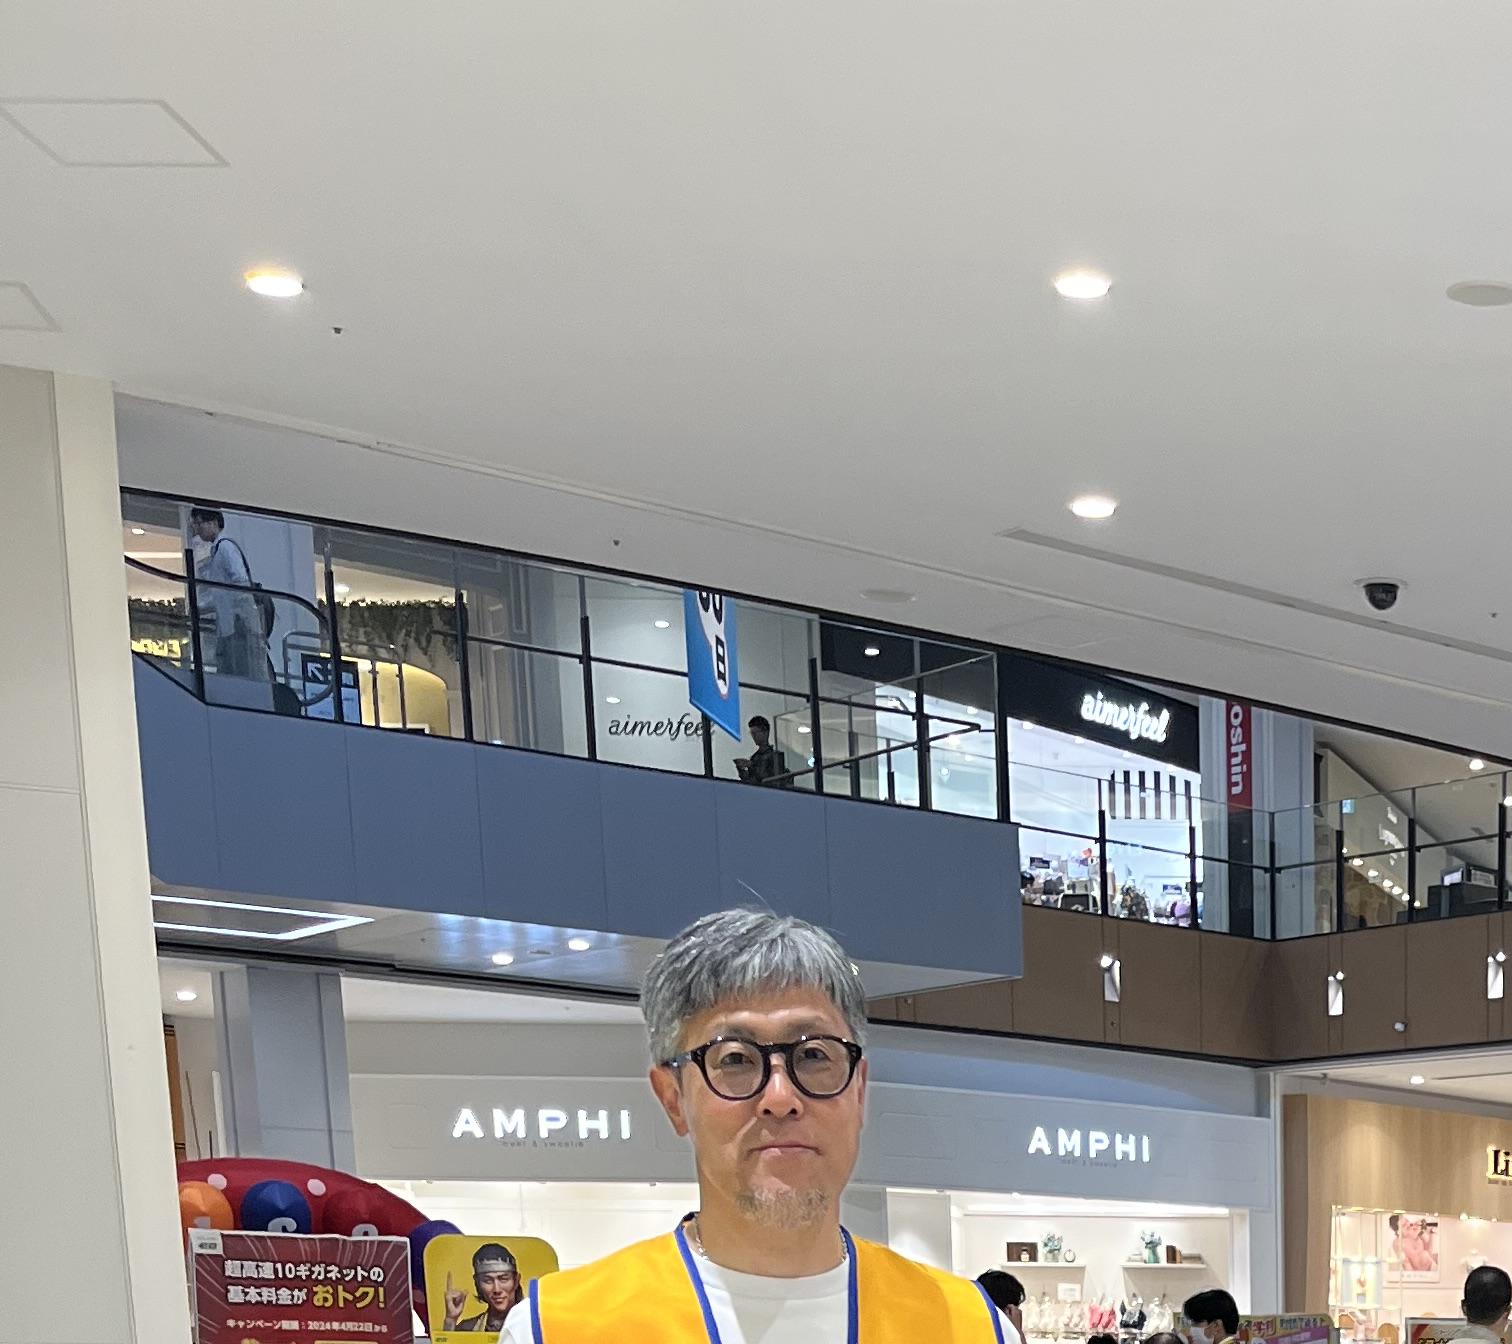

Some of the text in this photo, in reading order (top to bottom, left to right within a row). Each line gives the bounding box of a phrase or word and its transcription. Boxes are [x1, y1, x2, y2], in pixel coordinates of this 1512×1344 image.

[608, 713, 715, 740] aimerfee
[1081, 691, 1171, 743] aimerfeel
[1230, 704, 1247, 795] oshin
[452, 1108, 632, 1139] AMPHI
[1028, 1126, 1150, 1162] AMPHI
[227, 1285, 307, 1304] 基本料金が
